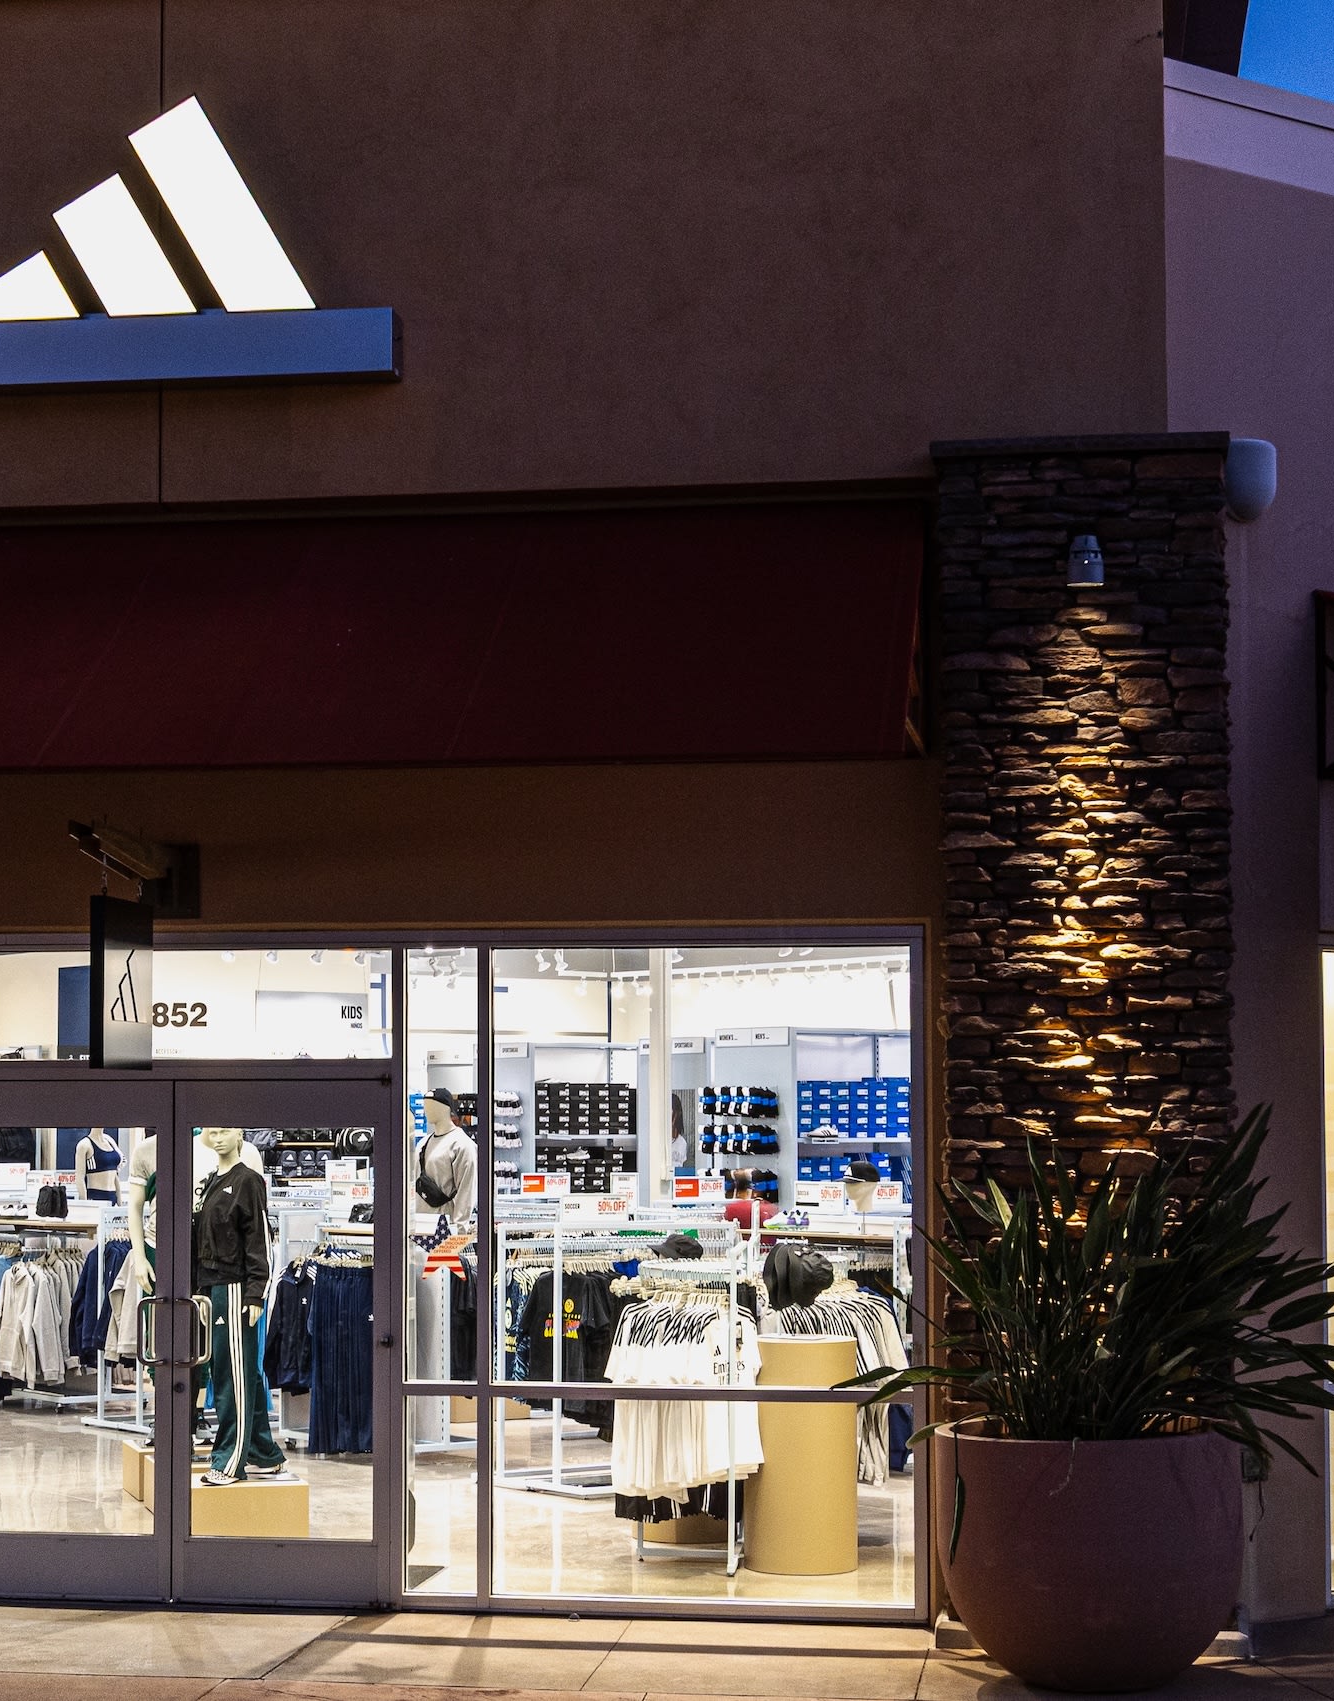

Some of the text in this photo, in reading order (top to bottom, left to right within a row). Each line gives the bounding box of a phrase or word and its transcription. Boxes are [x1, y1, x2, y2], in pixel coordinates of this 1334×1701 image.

[152, 1002, 208, 1028] 852
[341, 1005, 363, 1020] KIDS
[597, 1201, 612, 1212] 50%
[613, 1201, 627, 1211] OFF
